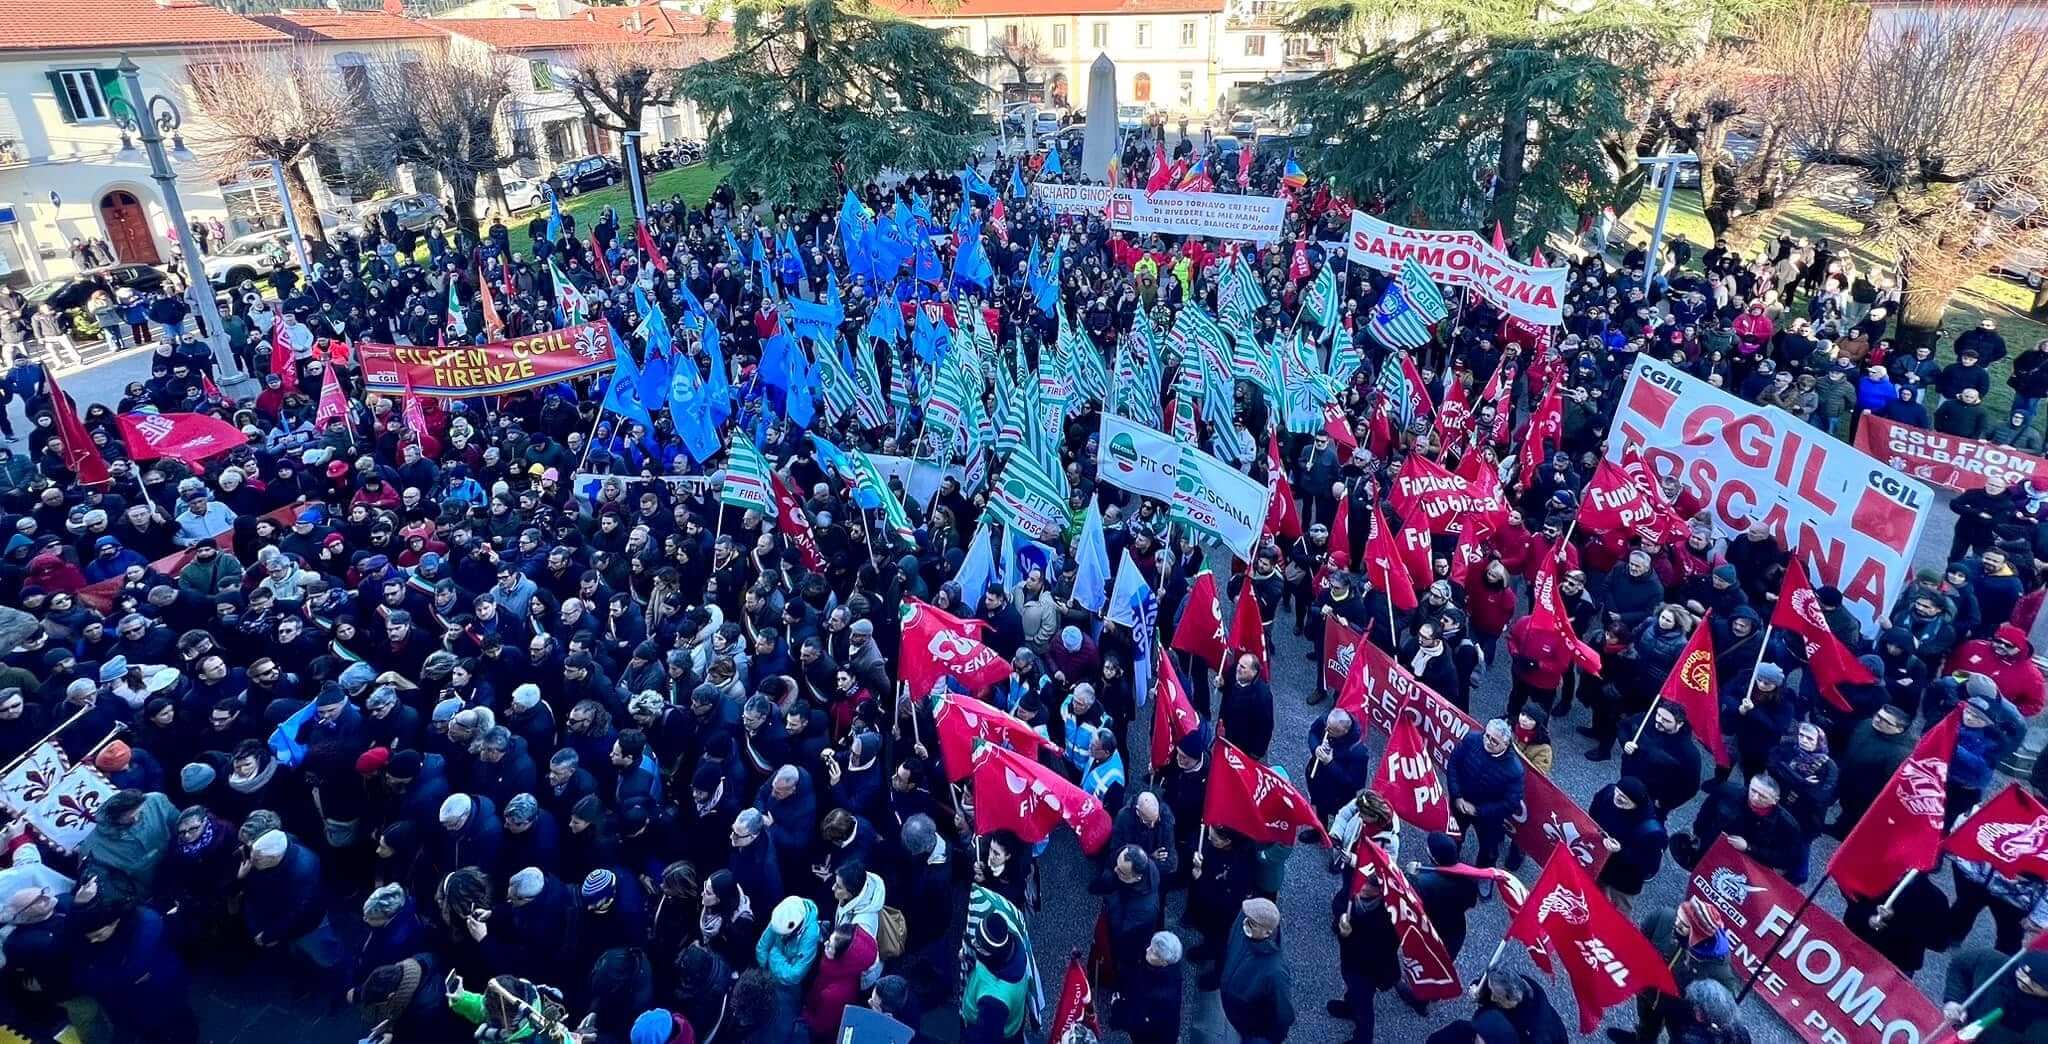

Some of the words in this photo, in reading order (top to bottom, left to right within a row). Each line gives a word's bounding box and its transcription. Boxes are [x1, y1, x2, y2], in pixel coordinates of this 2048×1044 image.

[1080, 187, 1112, 202] GINOR
[1113, 192, 1132, 200] CGIL
[1147, 199, 1183, 207] QUANDO
[1186, 200, 1226, 209] TORNAVO
[1165, 209, 1203, 217] RIVEDERE
[1204, 219, 1240, 230] BIANCHE
[1353, 231, 1558, 310] SAMMONTANA
[1415, 289, 1441, 317] CISL
[395, 346, 488, 368] FILCTEM
[511, 333, 572, 360] CGIL
[378, 375, 397, 383] CGIL
[433, 358, 536, 388] FIRENZE
[1639, 363, 1683, 395] CGIL
[1682, 404, 1838, 517] CGIL
[1888, 440, 2026, 484] GILBARCO
[1889, 425, 1948, 451] RSU
[1957, 441, 2037, 474] FIOM
[1140, 455, 1157, 473] FIT
[1162, 463, 1177, 478] CI
[1025, 493, 1049, 513] FIT
[1868, 470, 1920, 510] CGIL
[1018, 515, 1043, 536] TOSC
[1387, 666, 1421, 701] RSU
[1425, 694, 1471, 741] FIOM
[1695, 877, 1746, 927] FIOM-CGIL
[1724, 927, 1789, 998] ENZE
